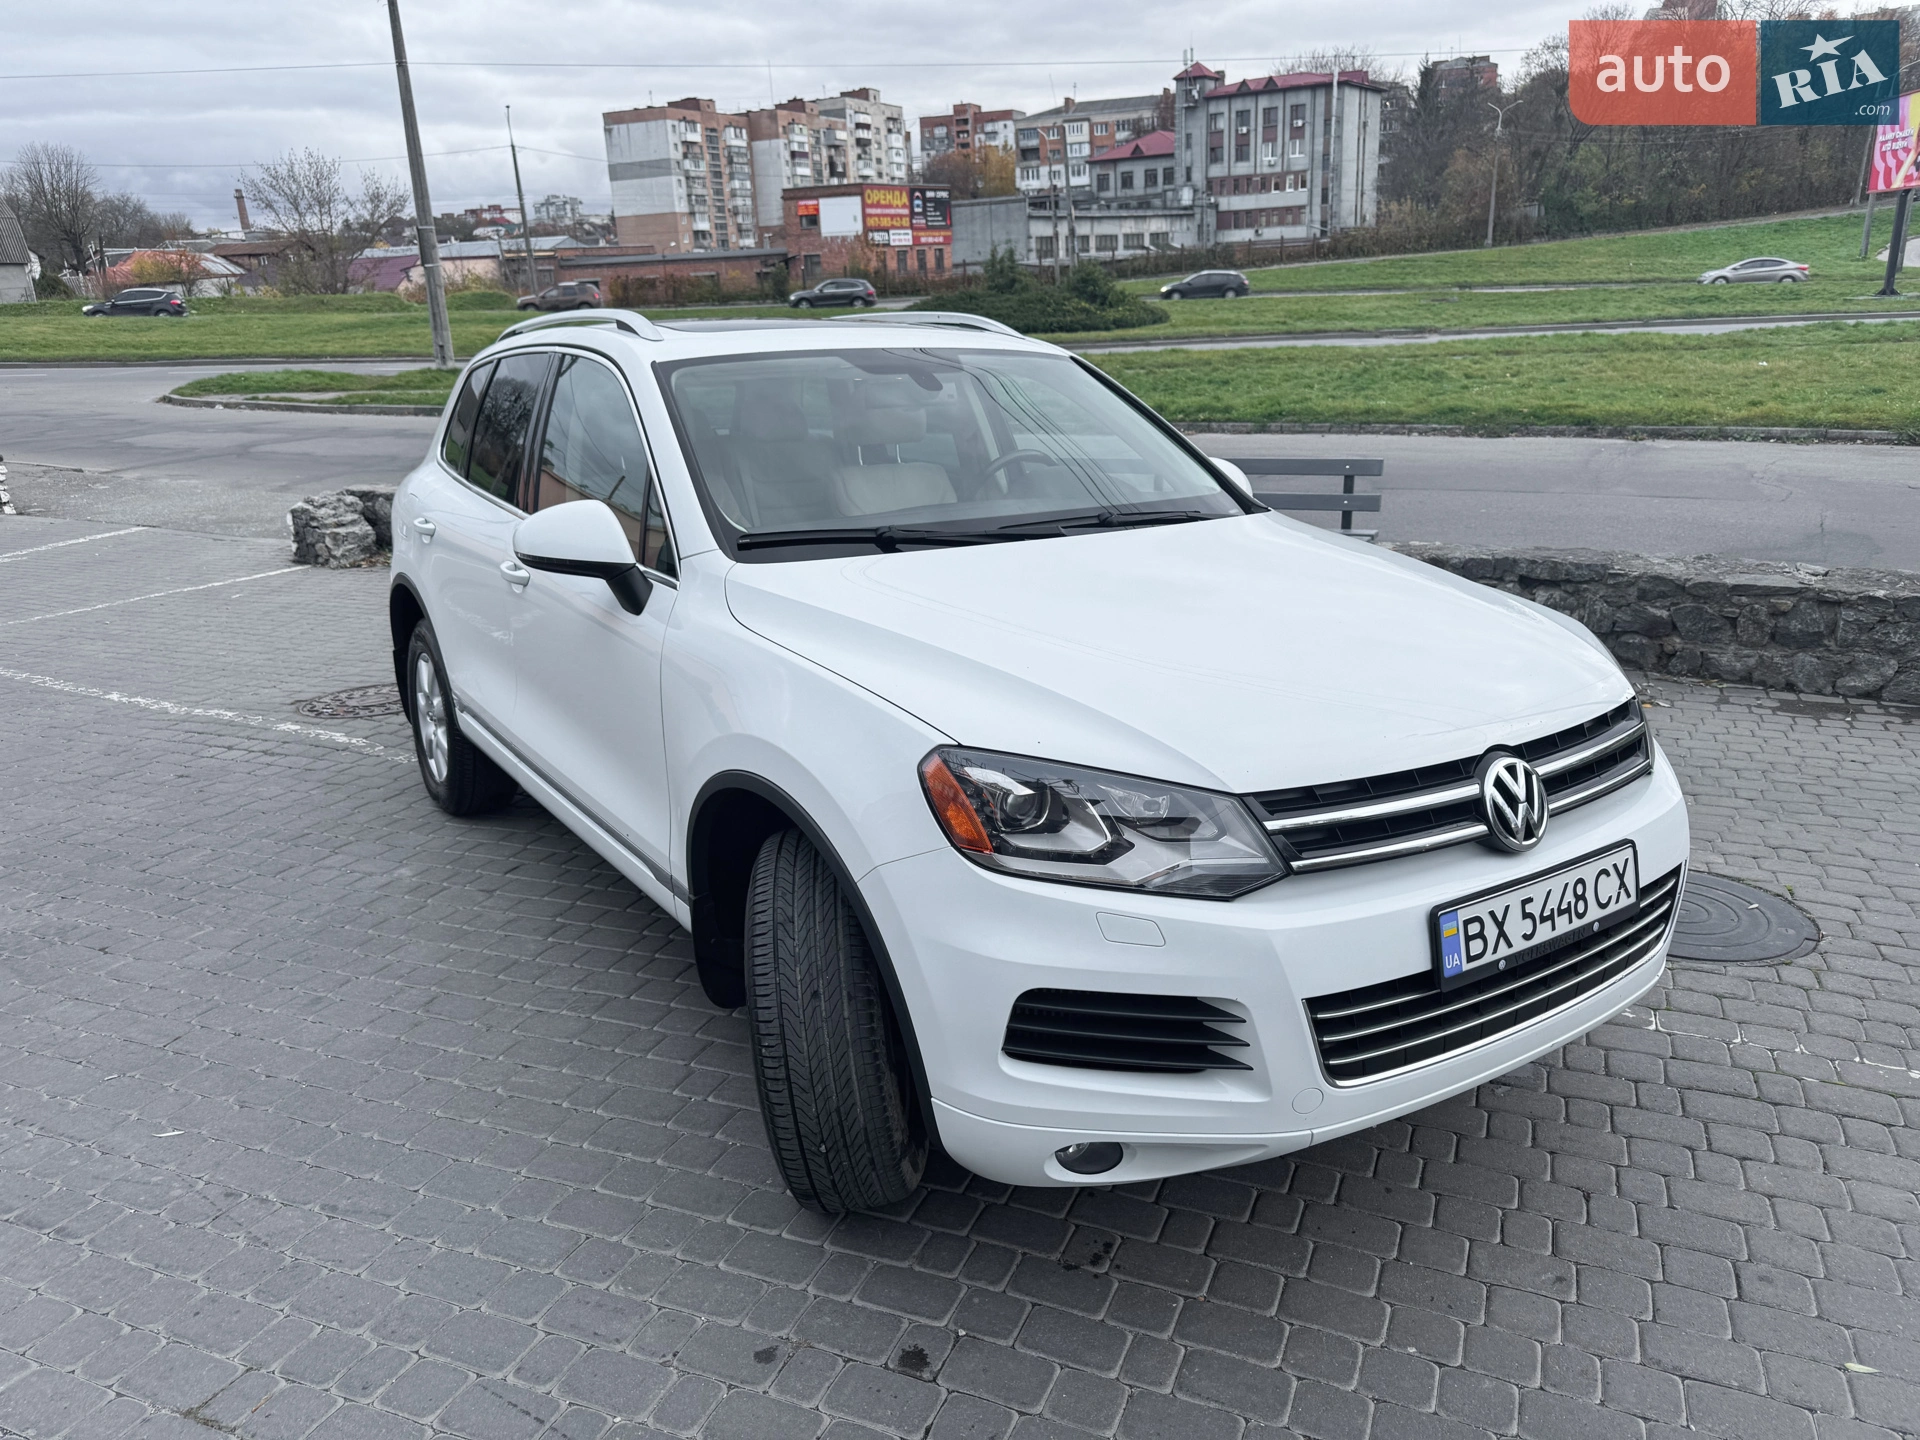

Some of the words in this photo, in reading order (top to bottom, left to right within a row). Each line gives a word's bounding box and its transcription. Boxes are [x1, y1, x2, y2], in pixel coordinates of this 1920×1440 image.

[865, 189, 909, 207] ОРЕНДА
[1462, 904, 1514, 964] BX
[1520, 877, 1589, 941] 5448
[1594, 857, 1632, 910] CX
[1445, 953, 1461, 969] UA
